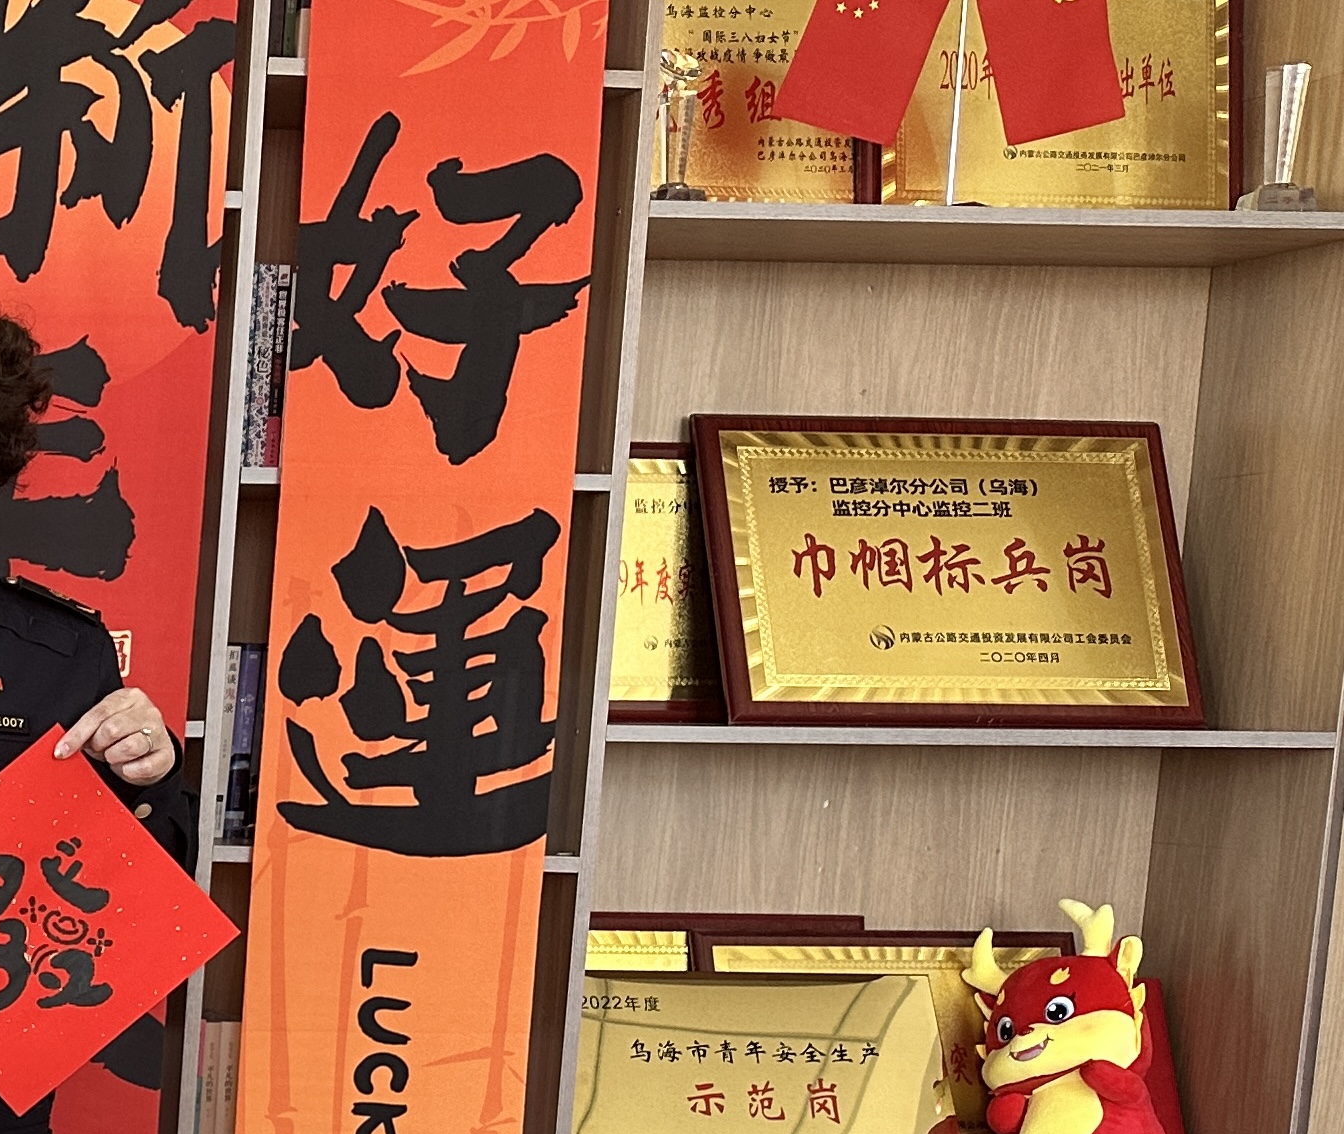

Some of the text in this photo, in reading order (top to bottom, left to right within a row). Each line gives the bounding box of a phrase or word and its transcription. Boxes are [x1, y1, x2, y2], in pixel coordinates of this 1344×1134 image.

[665, 3, 775, 21] 乌海监控分中心
[255, 346, 271, 374] 秘色
[831, 499, 1013, 519] 监控分中心监控二班
[791, 532, 1114, 600] 巾帼标兵岗
[899, 632, 1133, 645] 内蒙古公路交通投资发展有限公司工会委员会
[224, 650, 240, 714] 扪虱谈鬼录
[580, 995, 661, 1012] 2022年度
[629, 1039, 881, 1065] 乌海市青年安全生产
[686, 1078, 842, 1125] 示范岗
